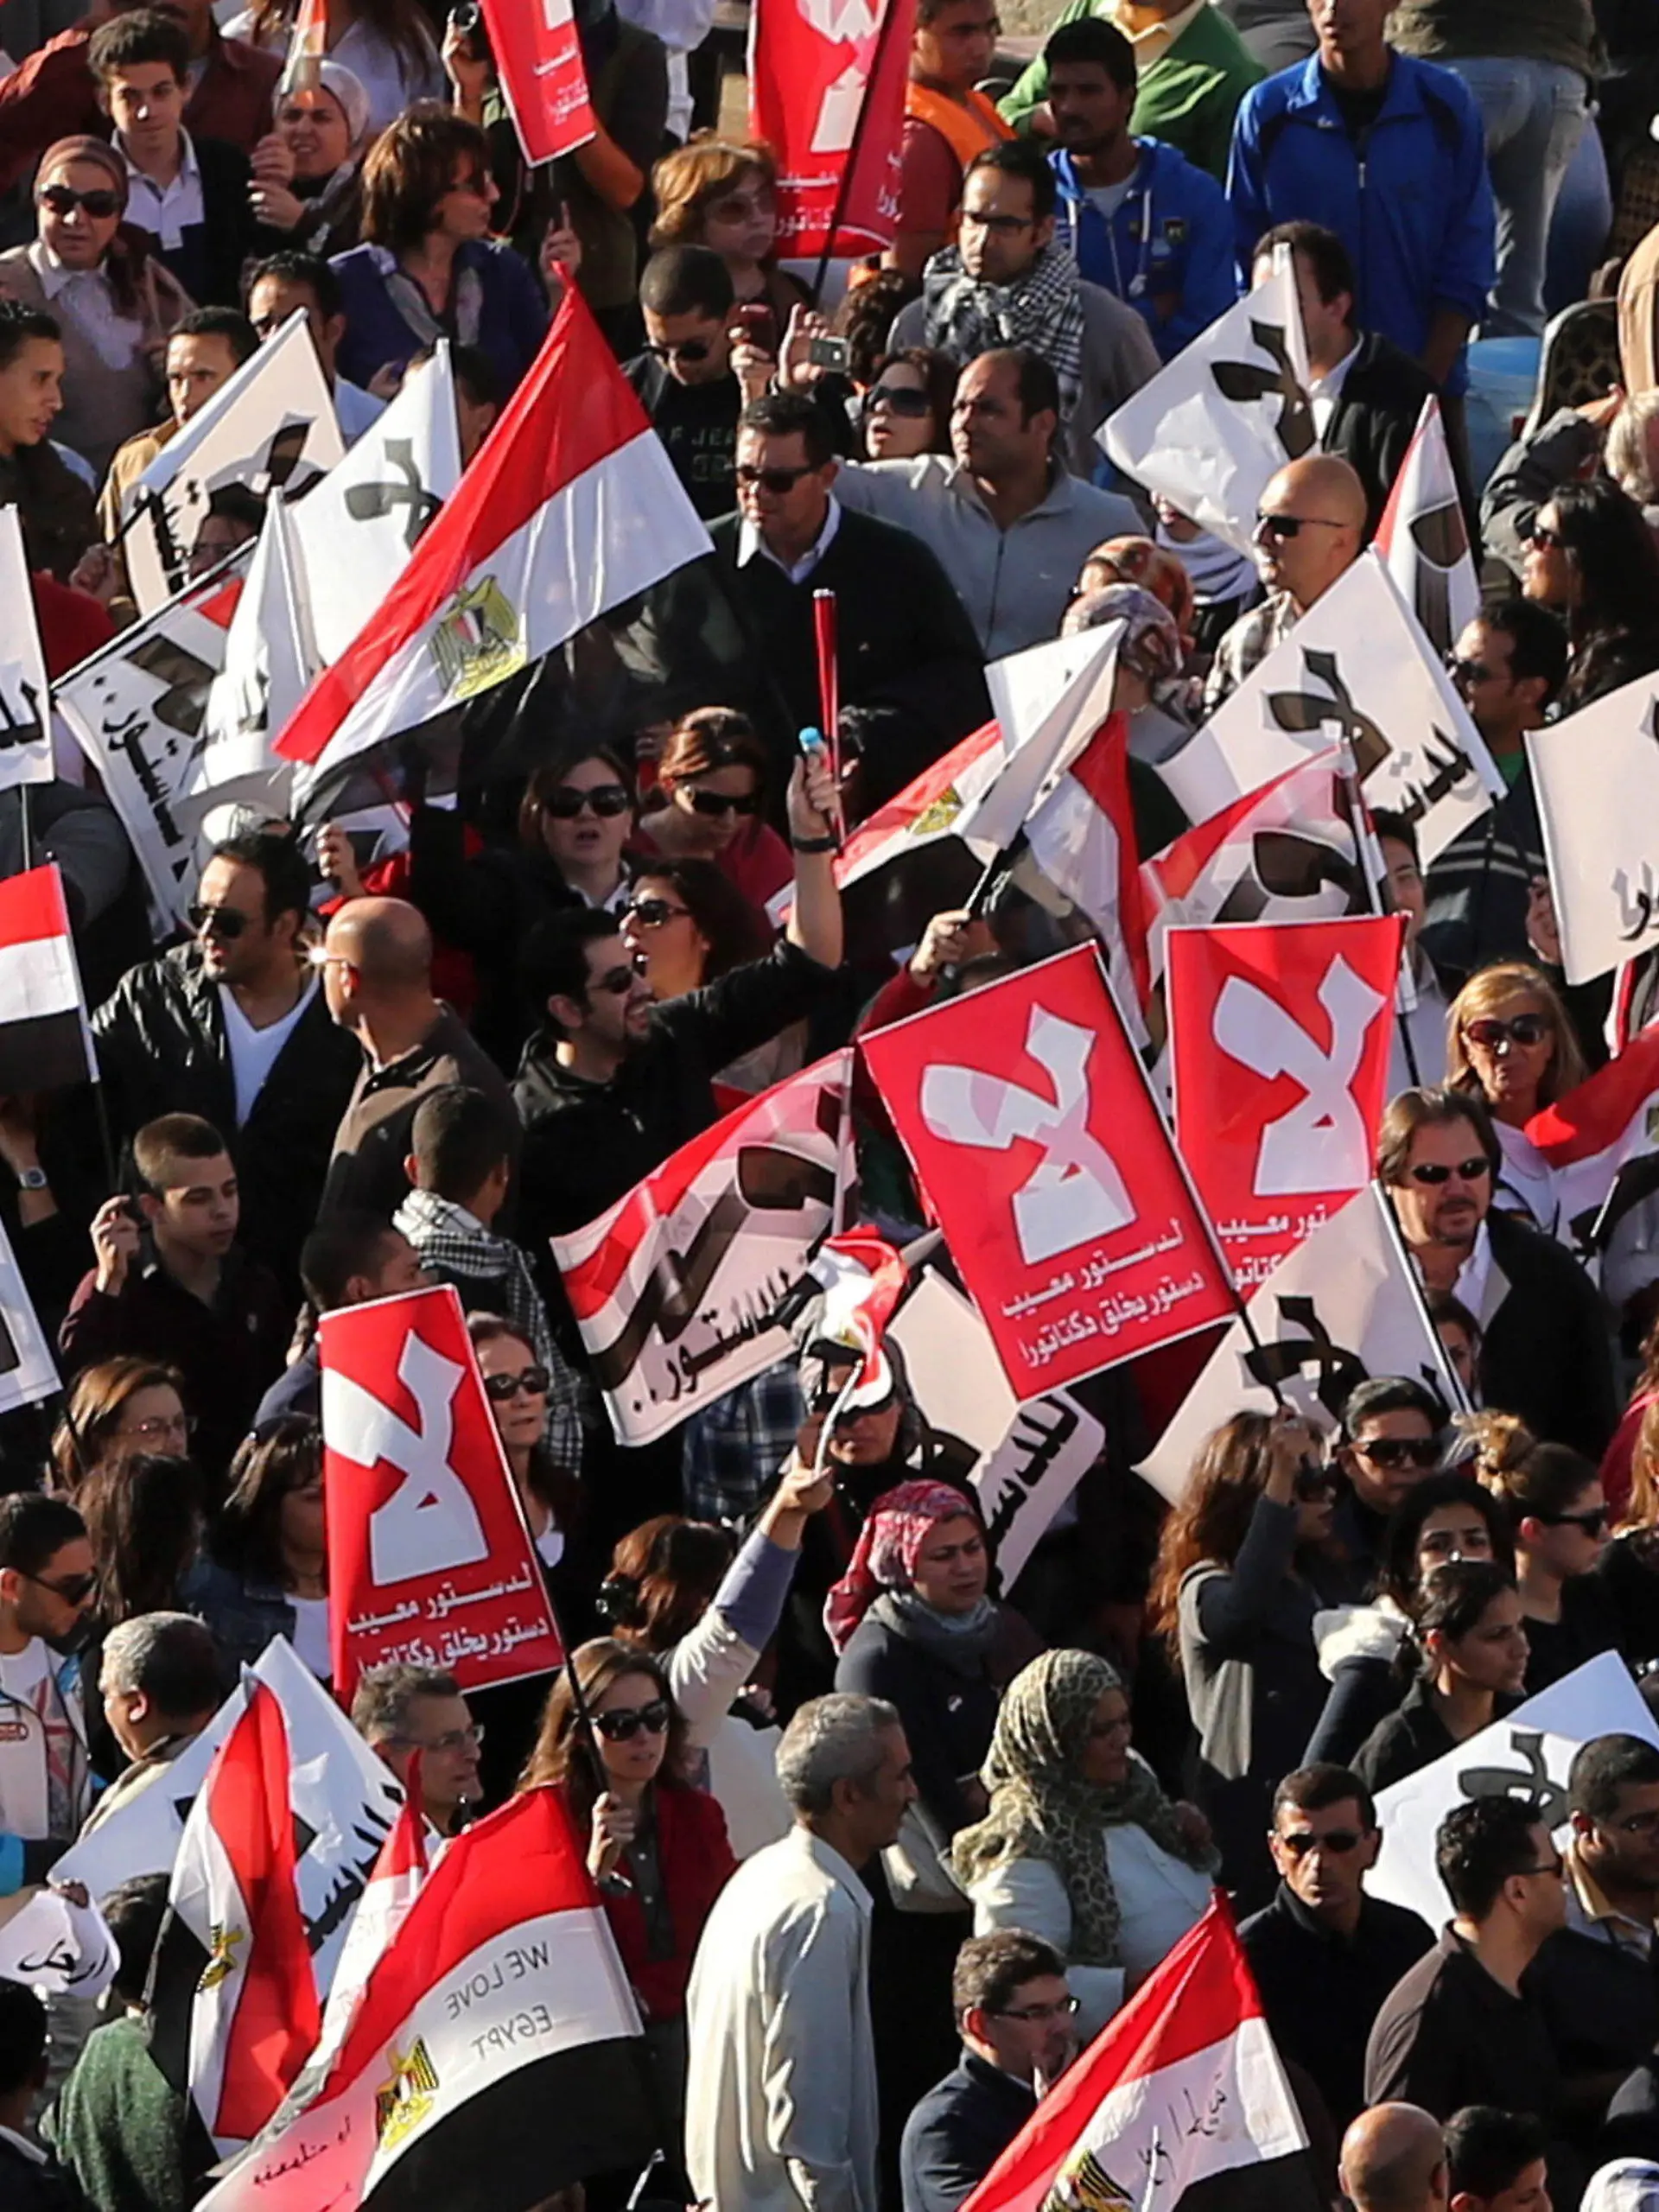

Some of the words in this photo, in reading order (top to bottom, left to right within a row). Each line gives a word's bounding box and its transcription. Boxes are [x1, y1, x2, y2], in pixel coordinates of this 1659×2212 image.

[1214, 952, 1388, 1197] لا
[920, 1001, 1139, 1266] لا
[1080, 1217, 1184, 1290] لدستور
[1217, 1215, 1289, 1244] معيب
[1001, 1271, 1076, 1320] معيب
[1098, 1291, 1147, 1336] يخلق
[1151, 1271, 1205, 1316] دستور
[1018, 1309, 1098, 1368] دكتاتورا
[321, 1329, 490, 1586] لا
[425, 1561, 533, 1619] لدستور
[346, 1600, 420, 1637] معيب
[490, 1616, 550, 1655] دستور
[439, 1626, 487, 1669] يخلق
